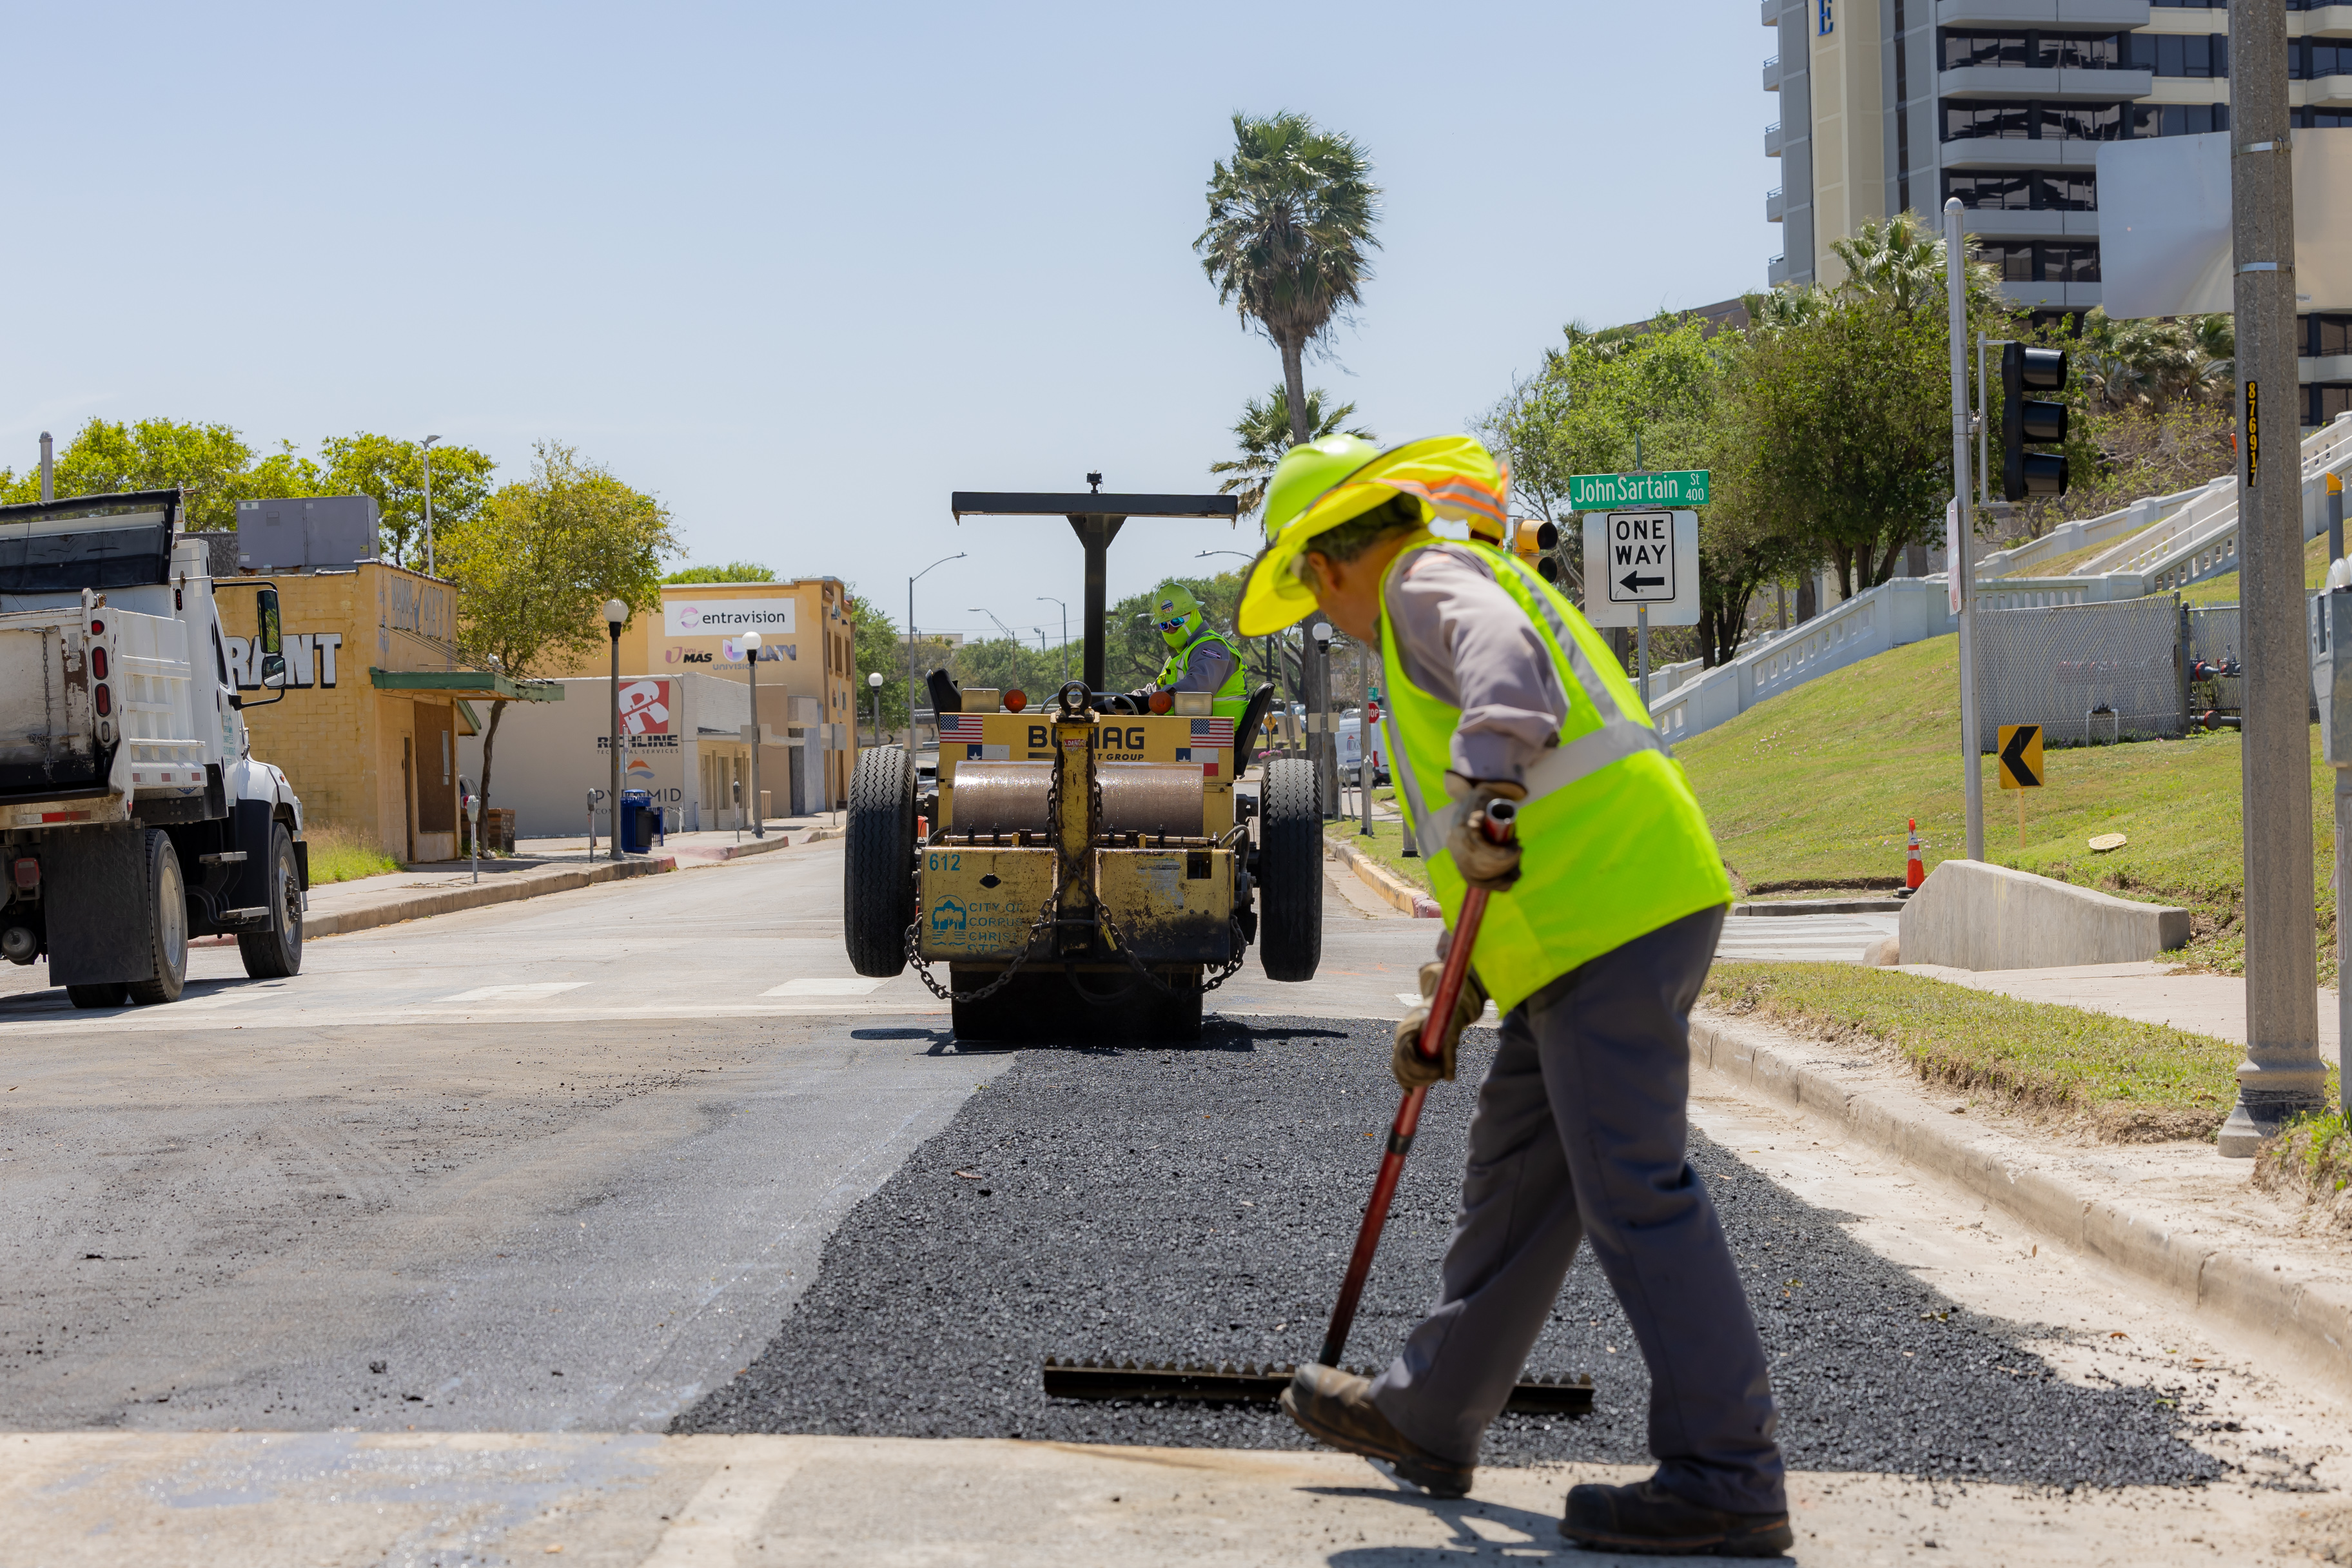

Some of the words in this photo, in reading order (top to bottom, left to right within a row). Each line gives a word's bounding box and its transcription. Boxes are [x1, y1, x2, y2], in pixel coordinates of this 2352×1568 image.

[1690, 473, 1700, 485] St
[1575, 478, 1615, 503] John
[1618, 475, 1678, 501] Sartain
[1685, 488, 1704, 501] 400
[1616, 520, 1665, 540] ONE
[1615, 544, 1667, 565] WAY
[702, 611, 785, 624] entravision
[1368, 709, 1379, 718] TOP
[597, 735, 678, 748] RHLINE
[1028, 725, 1145, 750] BAG
[595, 788, 681, 804] PMID
[929, 853, 961, 871] 612
[969, 903, 1000, 912] CITY
[1006, 903, 1023, 912] OF
[969, 917, 1023, 926] CORPUS
[968, 932, 1023, 941] CHRISTI
